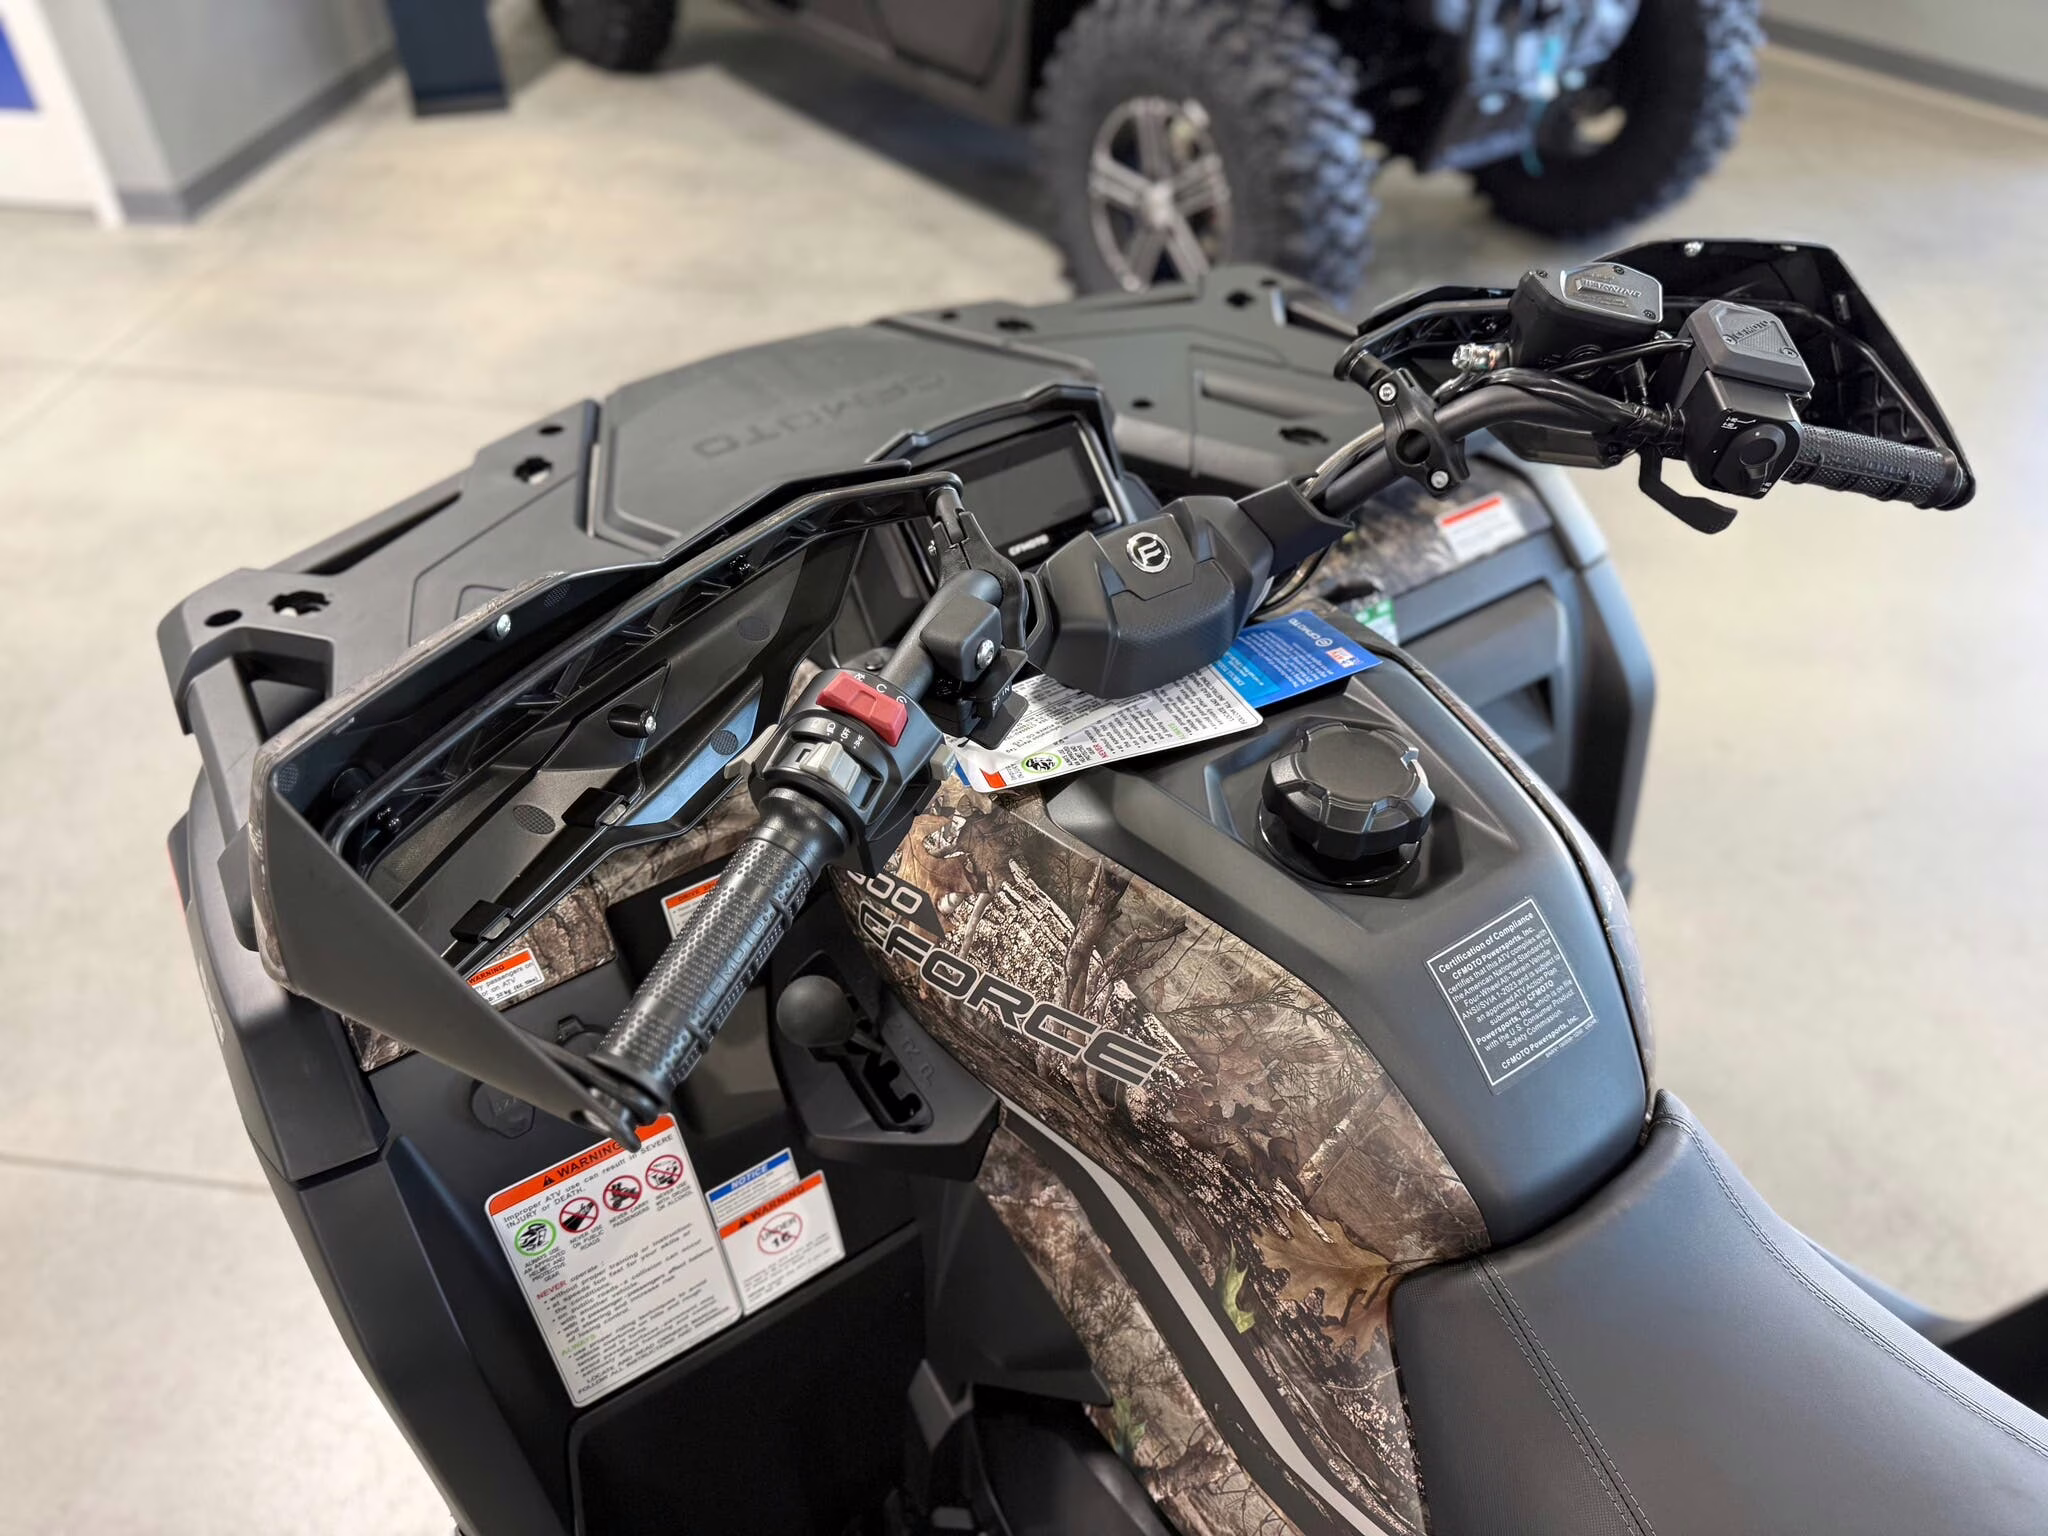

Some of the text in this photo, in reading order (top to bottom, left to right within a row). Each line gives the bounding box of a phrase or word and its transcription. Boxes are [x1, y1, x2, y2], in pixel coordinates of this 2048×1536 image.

[848, 869, 923, 914] 00
[1437, 910, 1534, 974] Certification of Compliance
[1451, 923, 1535, 980] CFMOTO Powersports, Inc.
[859, 901, 1169, 1088] CFORCE
[1500, 1046, 1530, 1070] CFMOTO
[1528, 1020, 1569, 1053] Powersports,
[1566, 1012, 1579, 1025] Inc.
[556, 1138, 624, 1179] WARNING
[729, 1163, 770, 1191] NOTICE
[749, 1183, 805, 1220] WARNING
[759, 1215, 797, 1242] UNDER
[771, 1230, 792, 1248] 16
[535, 1279, 567, 1300] NEVER
